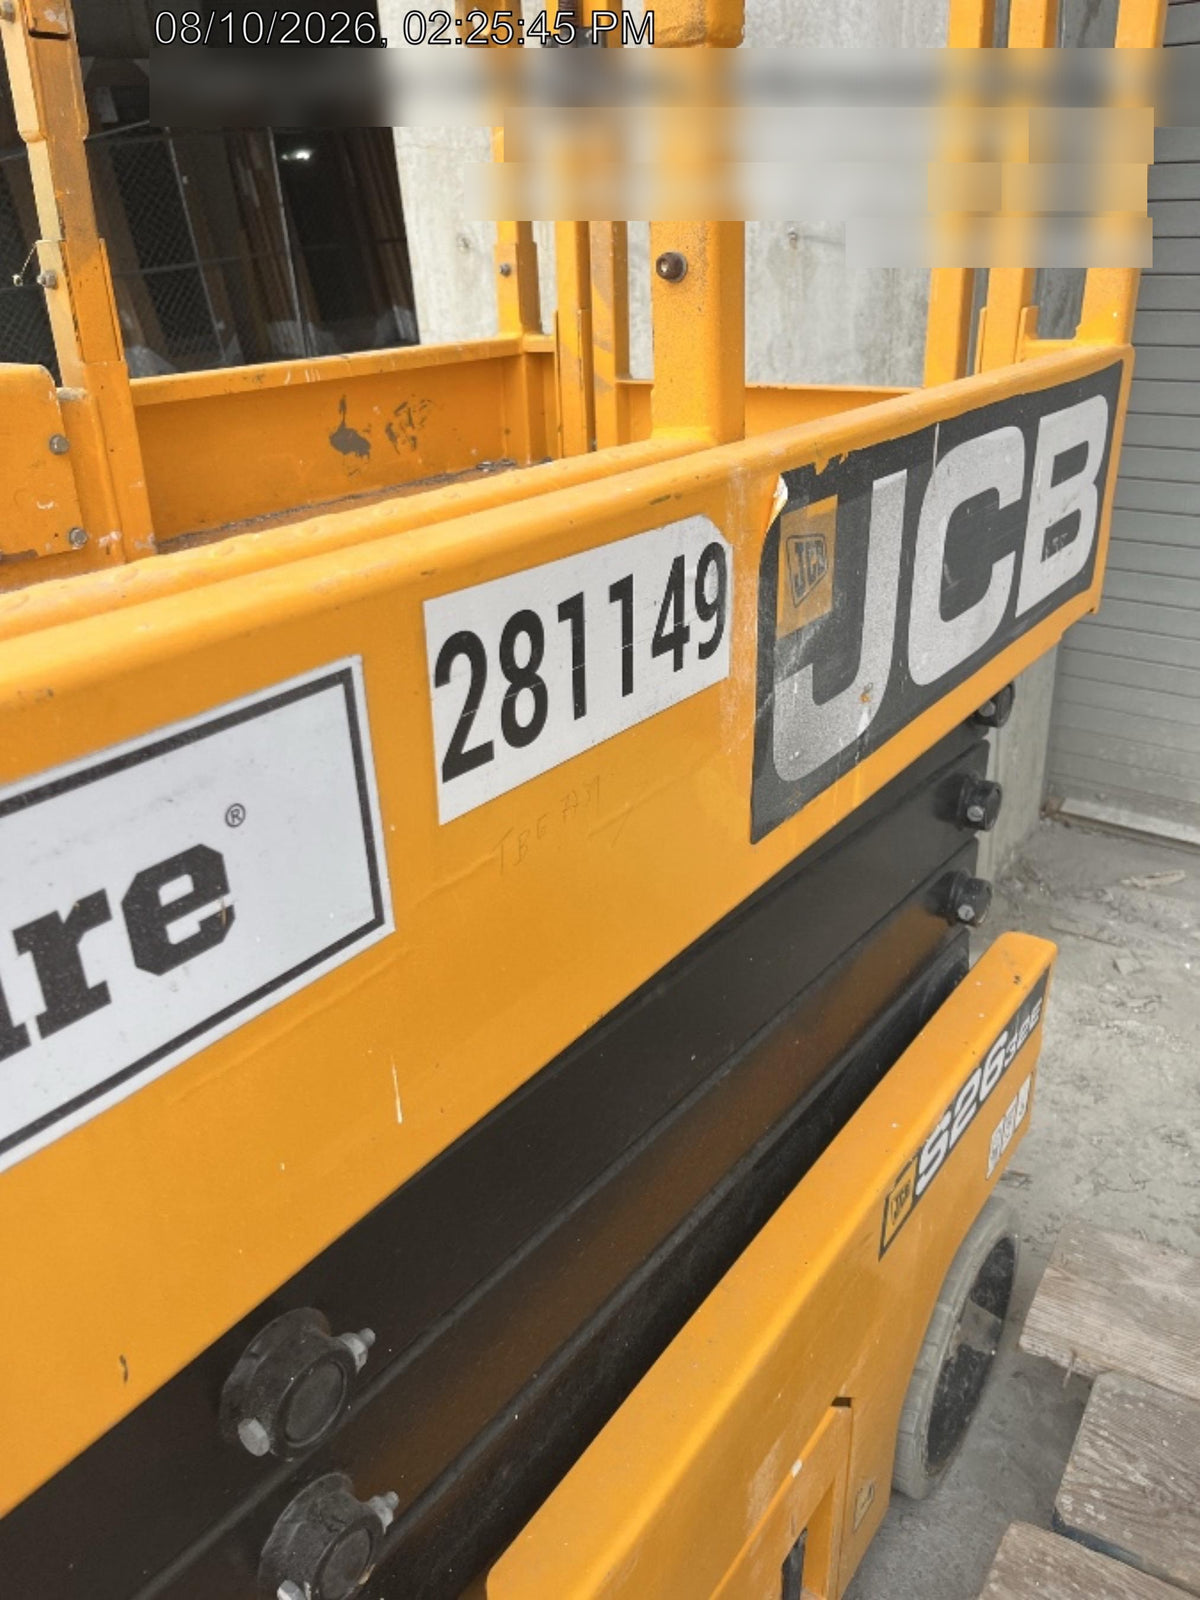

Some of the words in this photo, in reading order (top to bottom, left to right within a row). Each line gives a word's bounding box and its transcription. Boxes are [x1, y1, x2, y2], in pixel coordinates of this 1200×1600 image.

[434, 541, 728, 783] 281149
[773, 393, 1109, 782] JCB
[0, 843, 236, 1063] re
